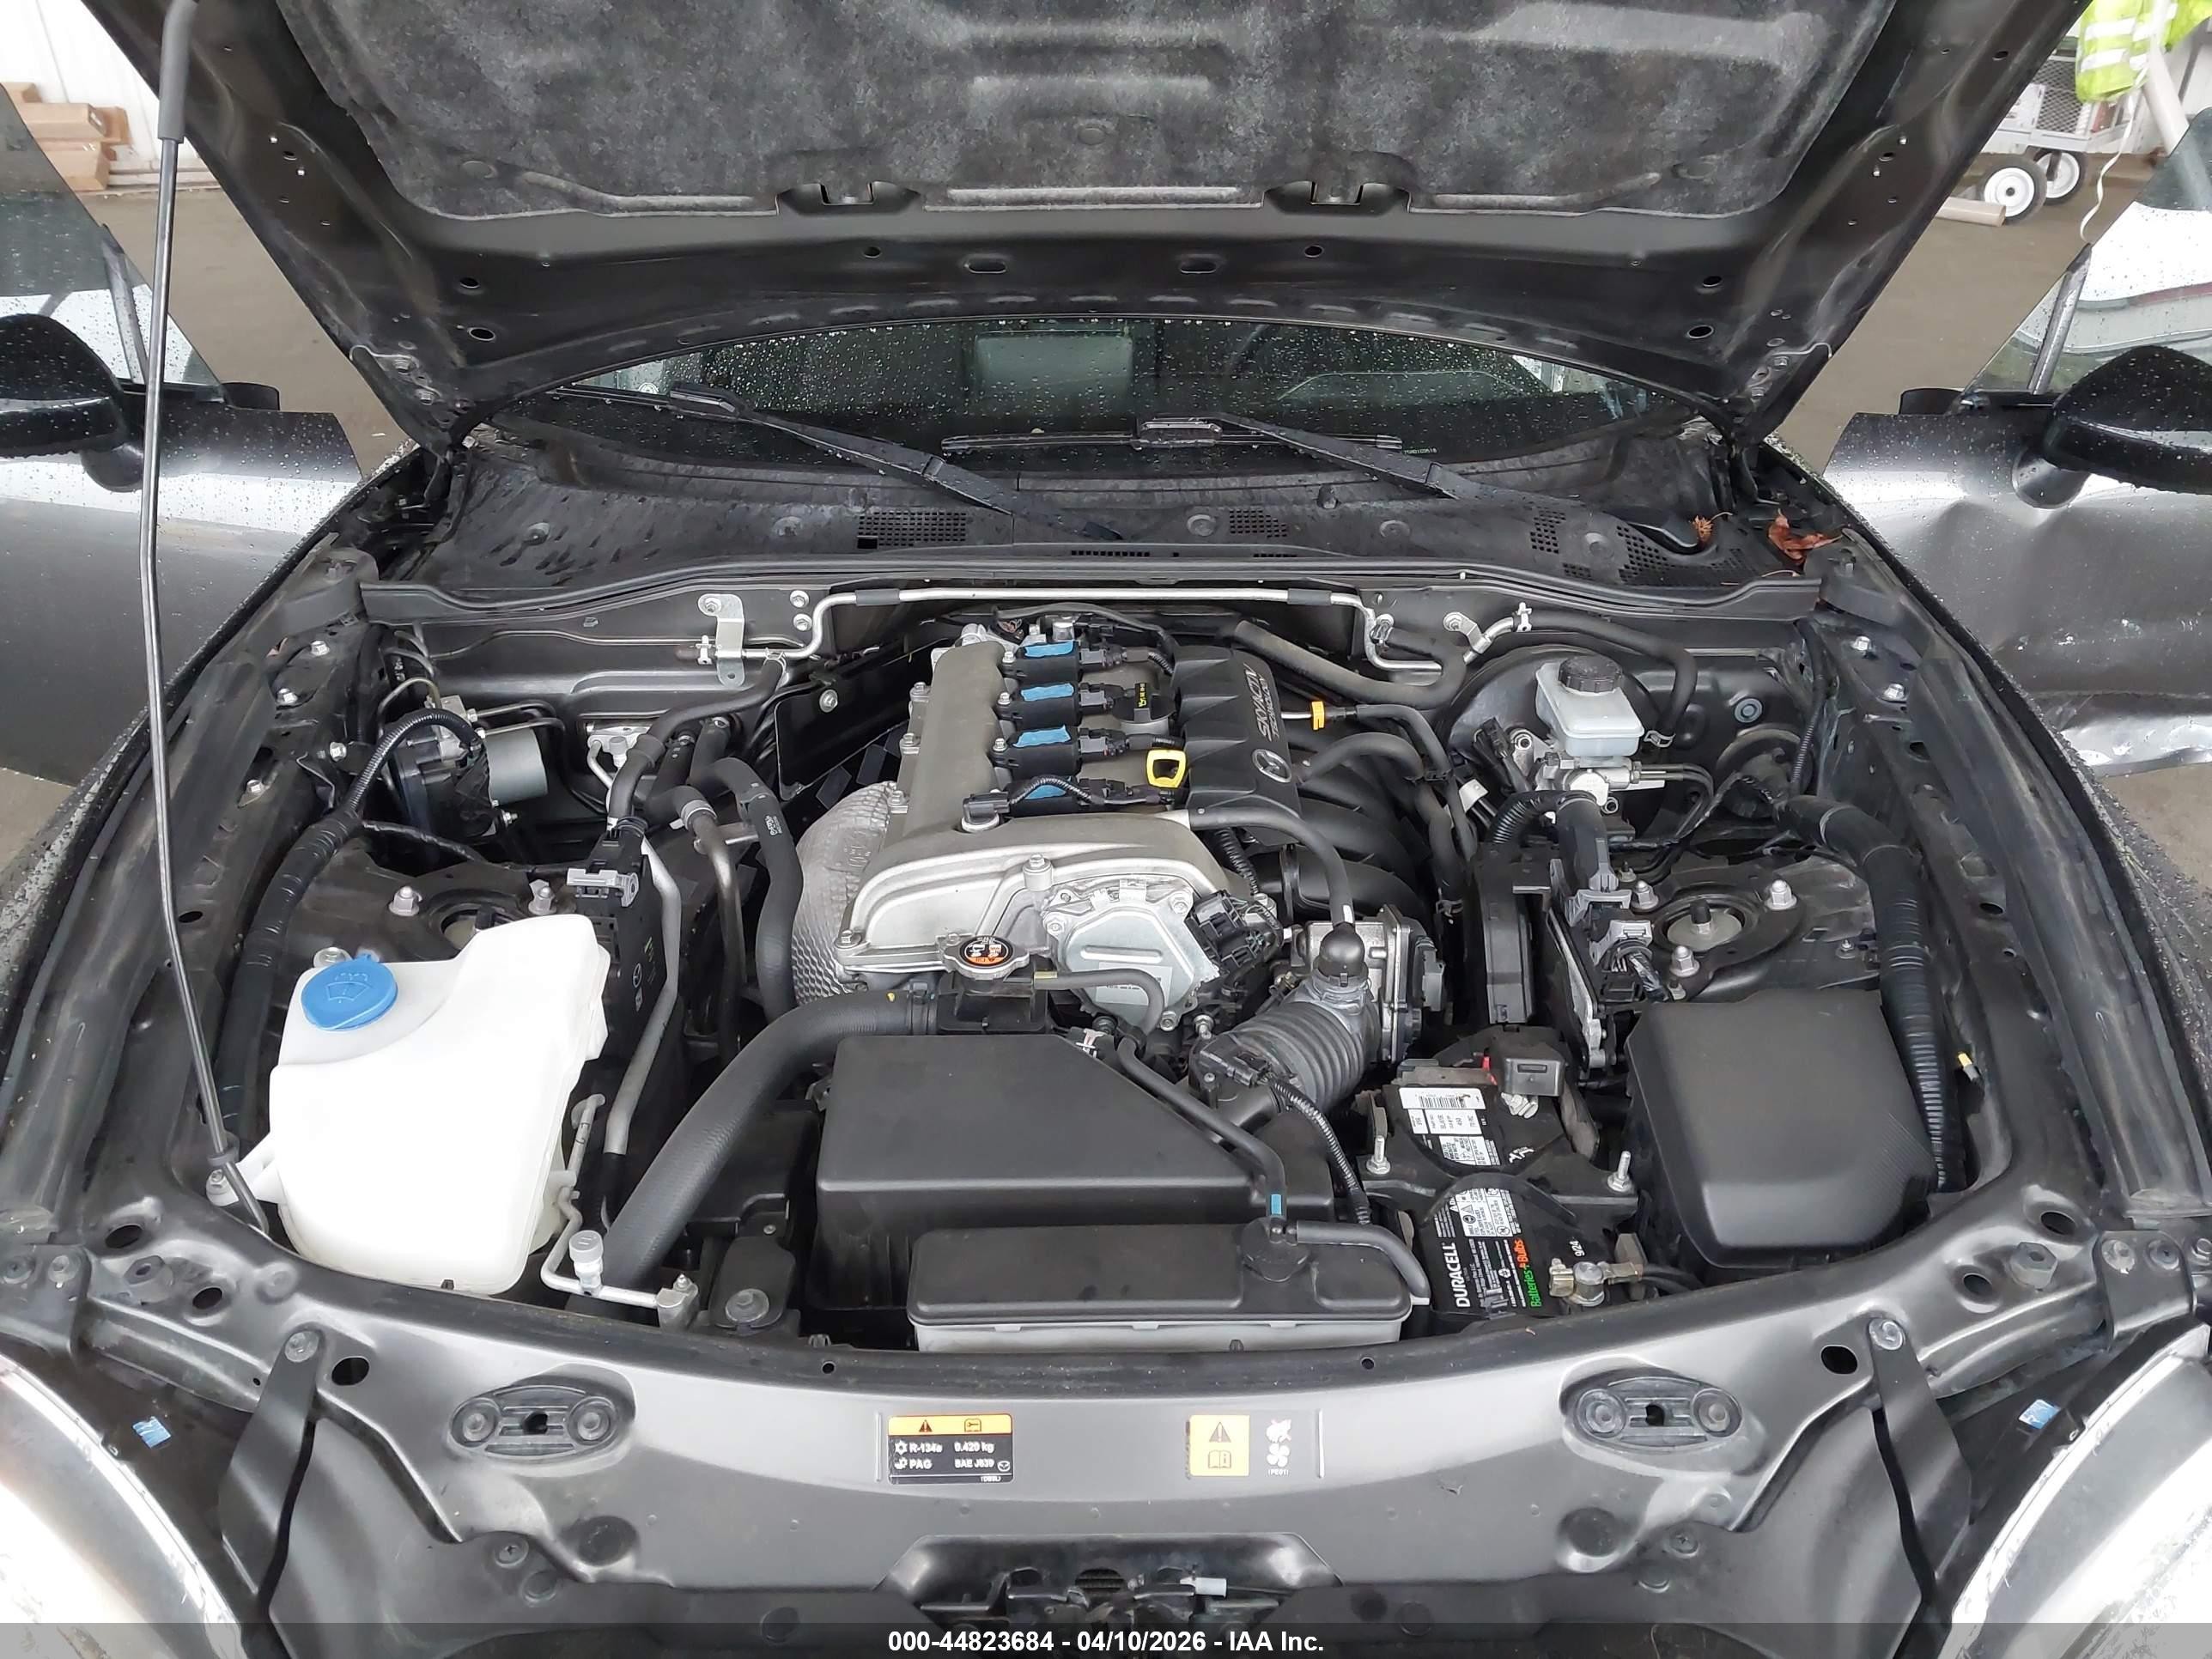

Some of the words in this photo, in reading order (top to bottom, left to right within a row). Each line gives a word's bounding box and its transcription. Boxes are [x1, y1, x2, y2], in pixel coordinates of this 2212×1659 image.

[1442, 1242, 1471, 1309] DURACELL
[908, 1442, 944, 1453] R-134a
[954, 1441, 980, 1452] 0.420
[981, 1441, 994, 1453] kg
[908, 1458, 933, 1469] PAG
